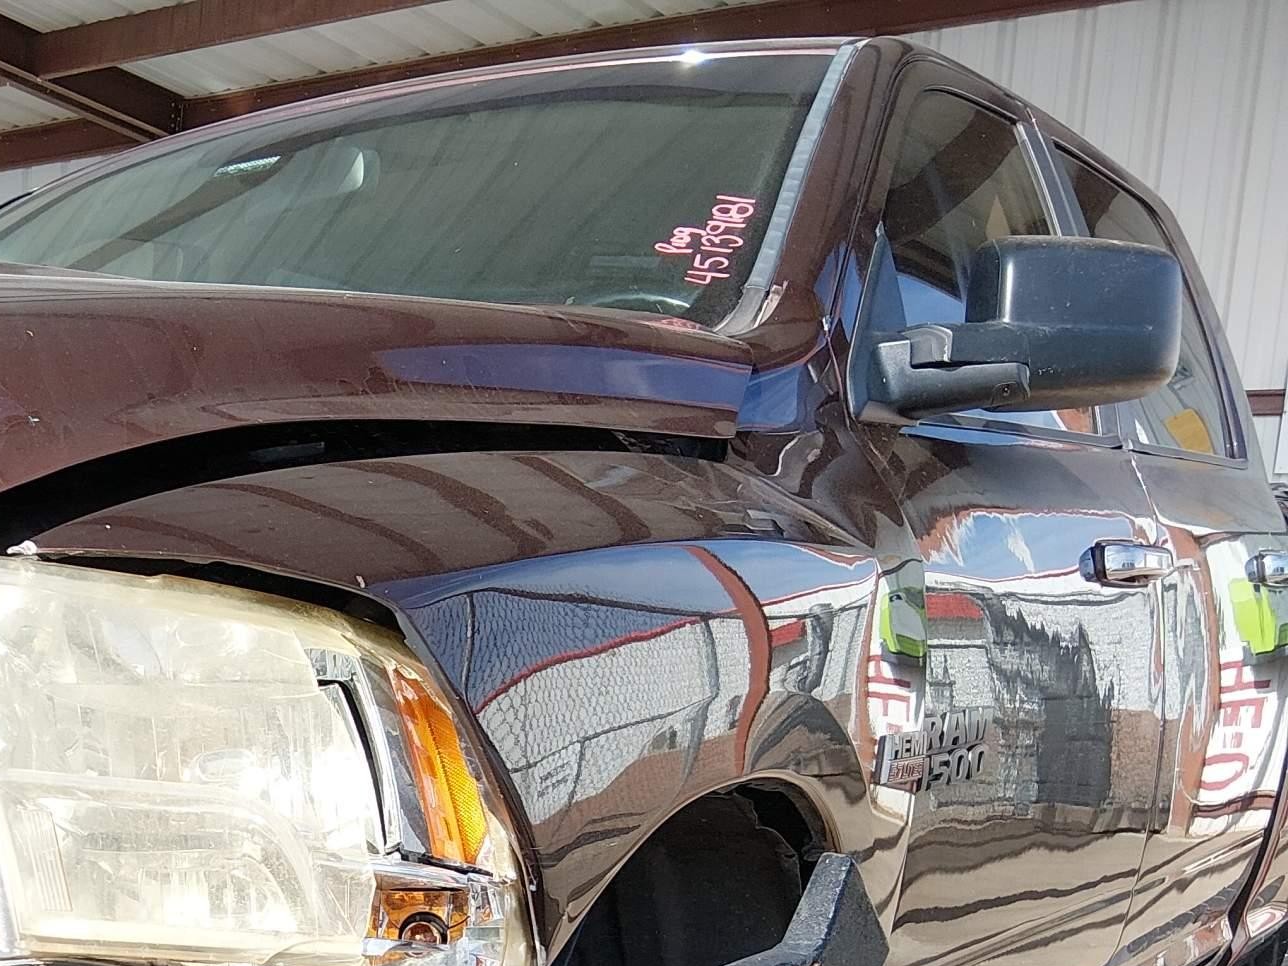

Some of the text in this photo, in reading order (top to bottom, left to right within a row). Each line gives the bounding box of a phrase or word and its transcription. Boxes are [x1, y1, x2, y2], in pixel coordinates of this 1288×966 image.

[684, 194, 756, 285] 45139181
[923, 708, 993, 752] RAM
[920, 744, 986, 793] 1500
